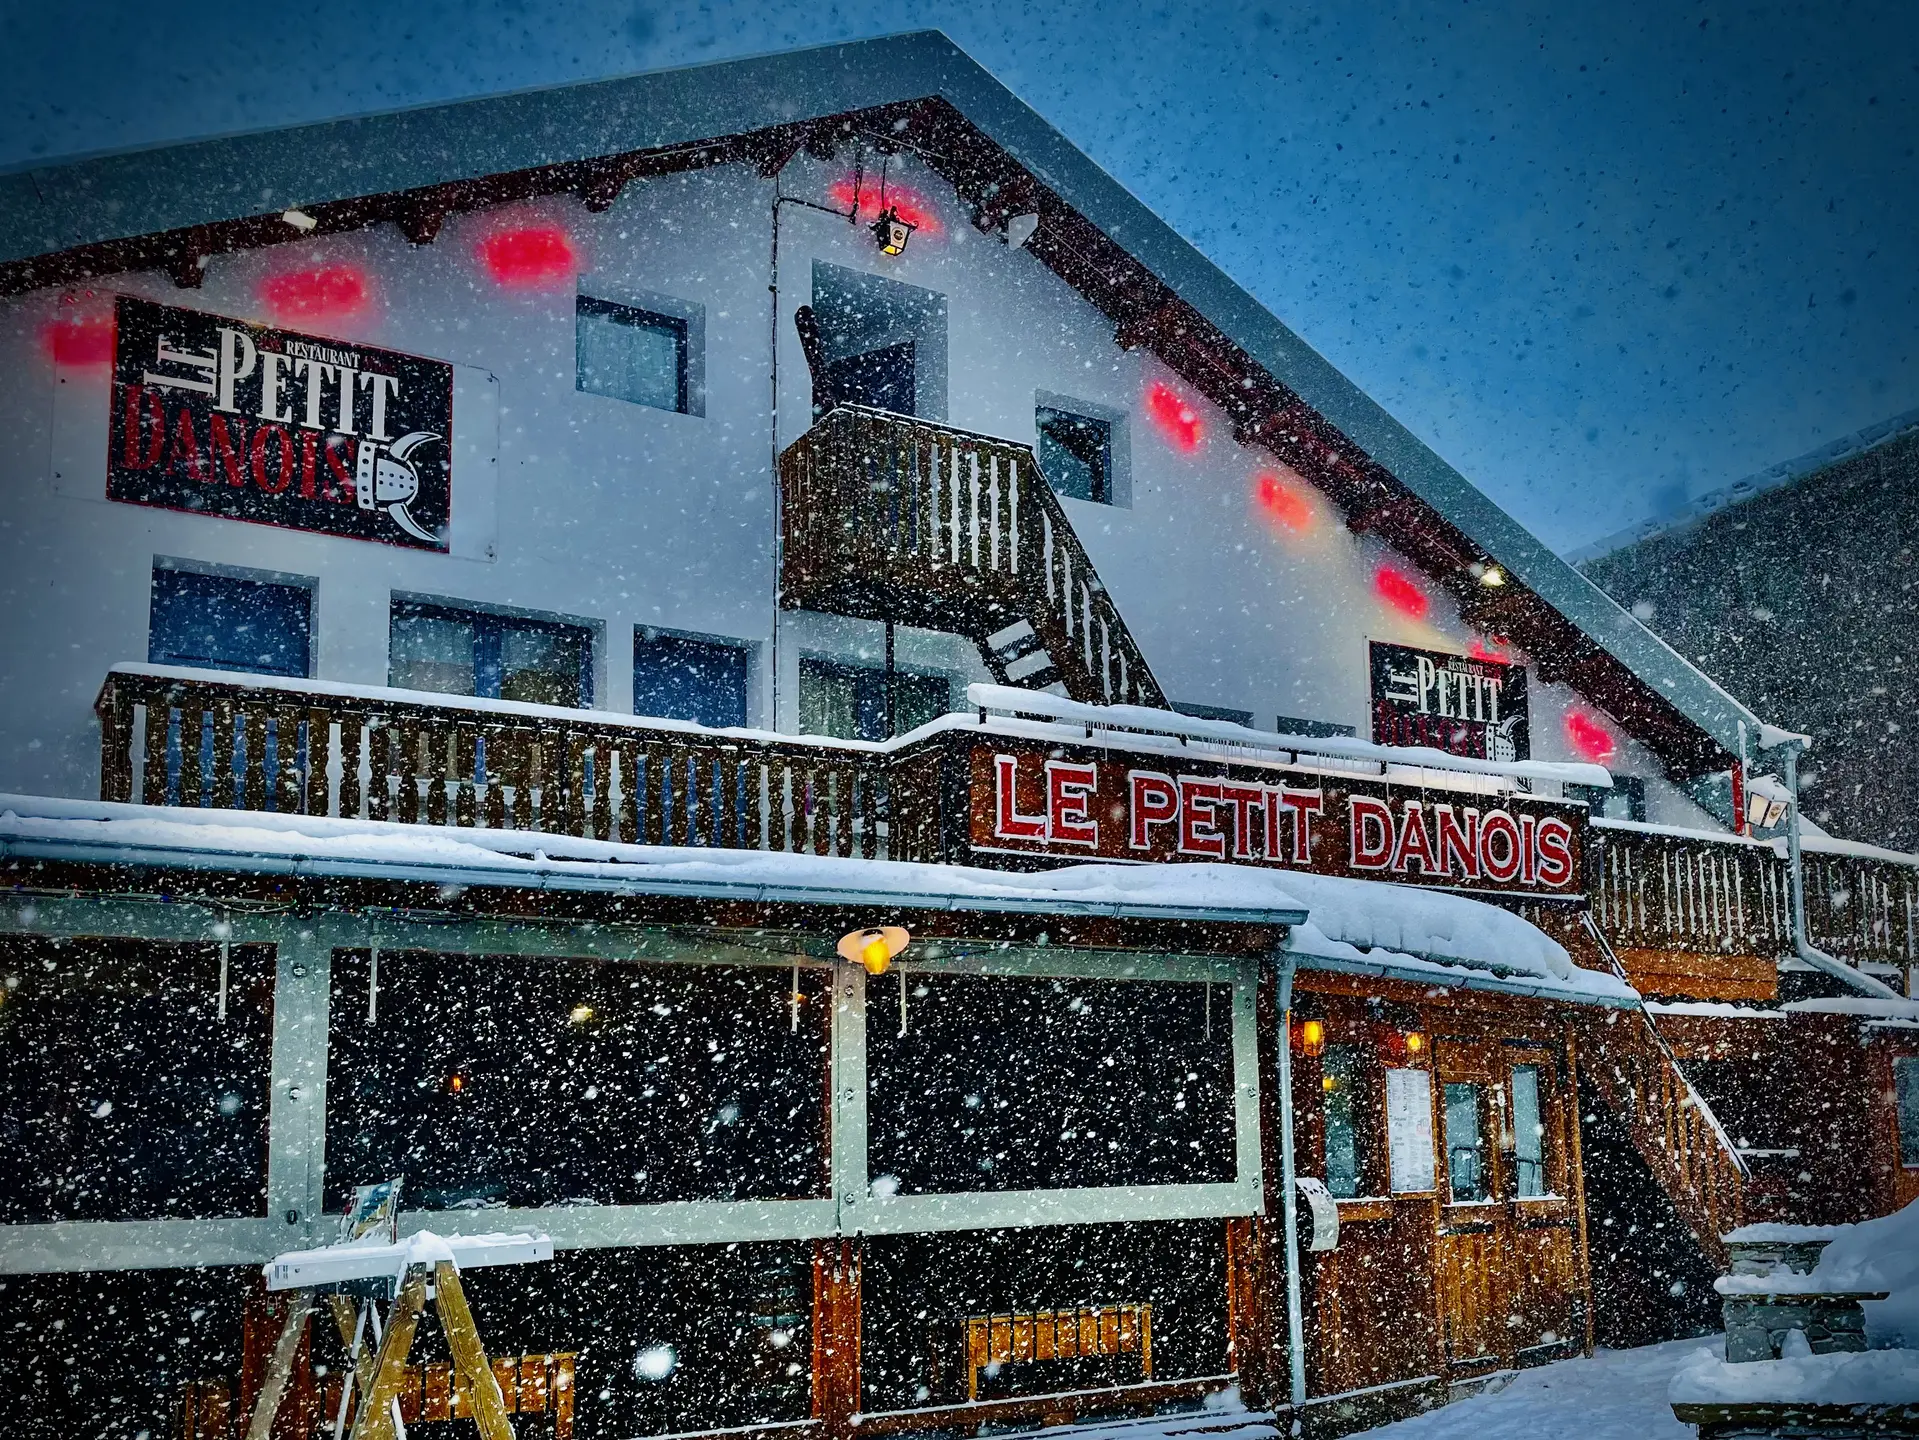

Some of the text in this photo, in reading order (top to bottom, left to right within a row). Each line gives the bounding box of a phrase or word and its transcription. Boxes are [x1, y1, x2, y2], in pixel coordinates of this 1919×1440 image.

[143, 334, 217, 397] LE
[213, 327, 399, 442] PETIT
[286, 340, 361, 368] RESTAURANT
[121, 384, 356, 504] DANOIS
[1414, 655, 1502, 724] PETIT
[994, 754, 1574, 887] LE PETIT DANOIS
